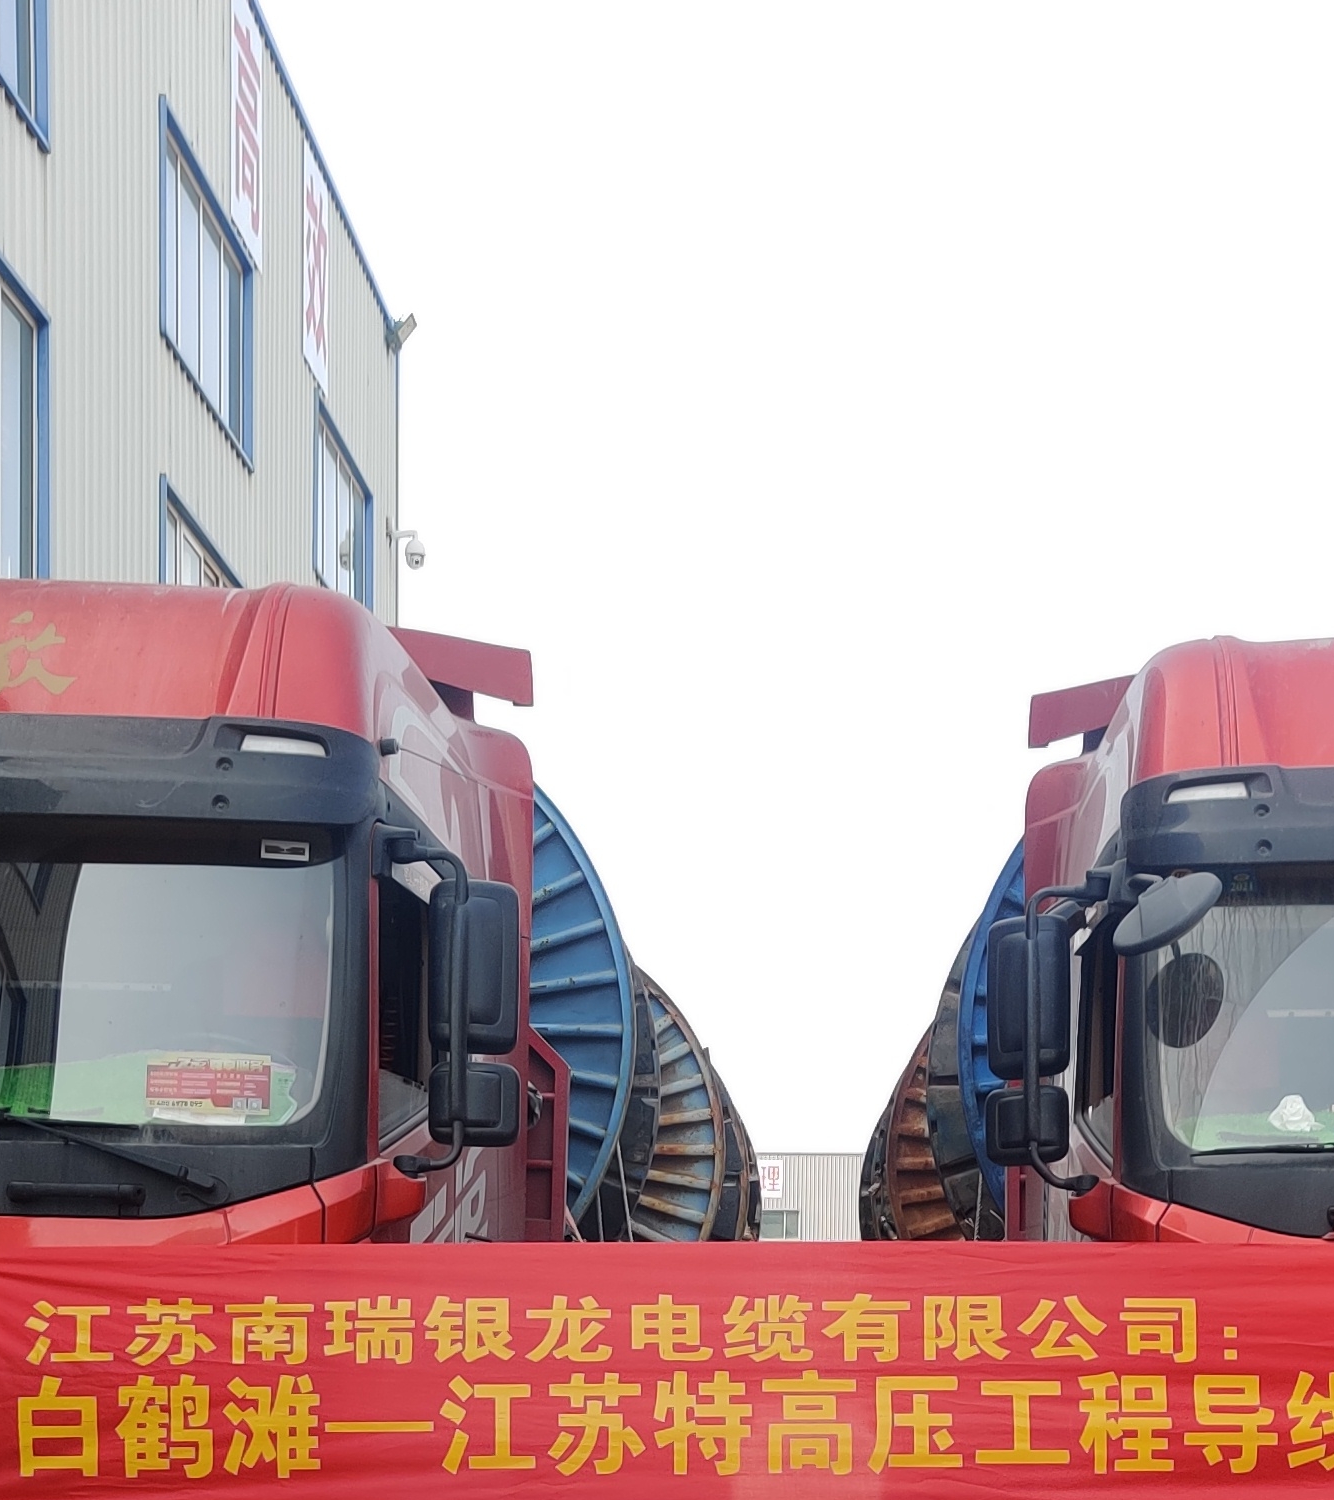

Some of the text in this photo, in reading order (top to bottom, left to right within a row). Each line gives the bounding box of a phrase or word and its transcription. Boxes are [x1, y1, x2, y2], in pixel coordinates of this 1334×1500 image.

[24, 1292, 1238, 1365] 江苏南瑞银龙电缆有限公司：
